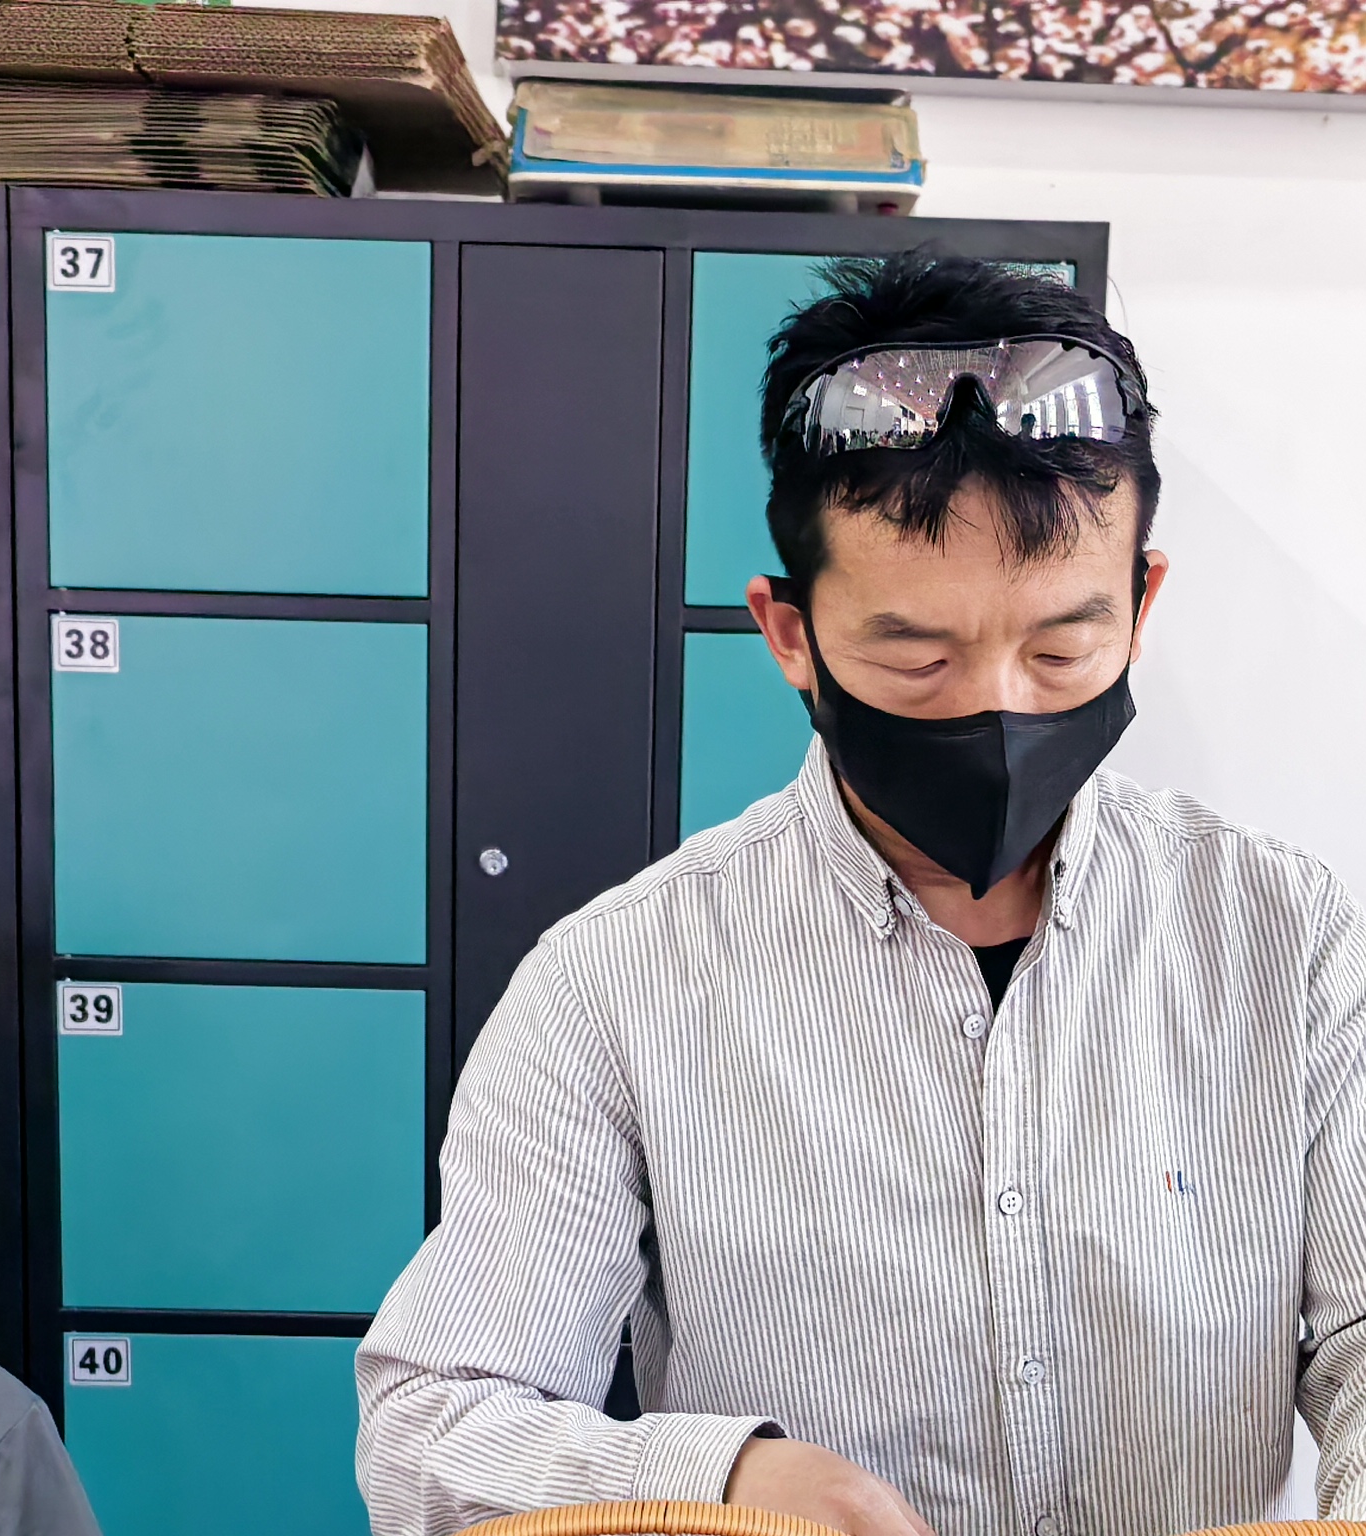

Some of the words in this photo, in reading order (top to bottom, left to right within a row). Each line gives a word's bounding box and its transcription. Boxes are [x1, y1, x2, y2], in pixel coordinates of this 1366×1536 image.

[61, 247, 106, 280] 37
[64, 629, 111, 662] 38
[68, 993, 114, 1025] 39
[77, 1347, 123, 1377] 40
